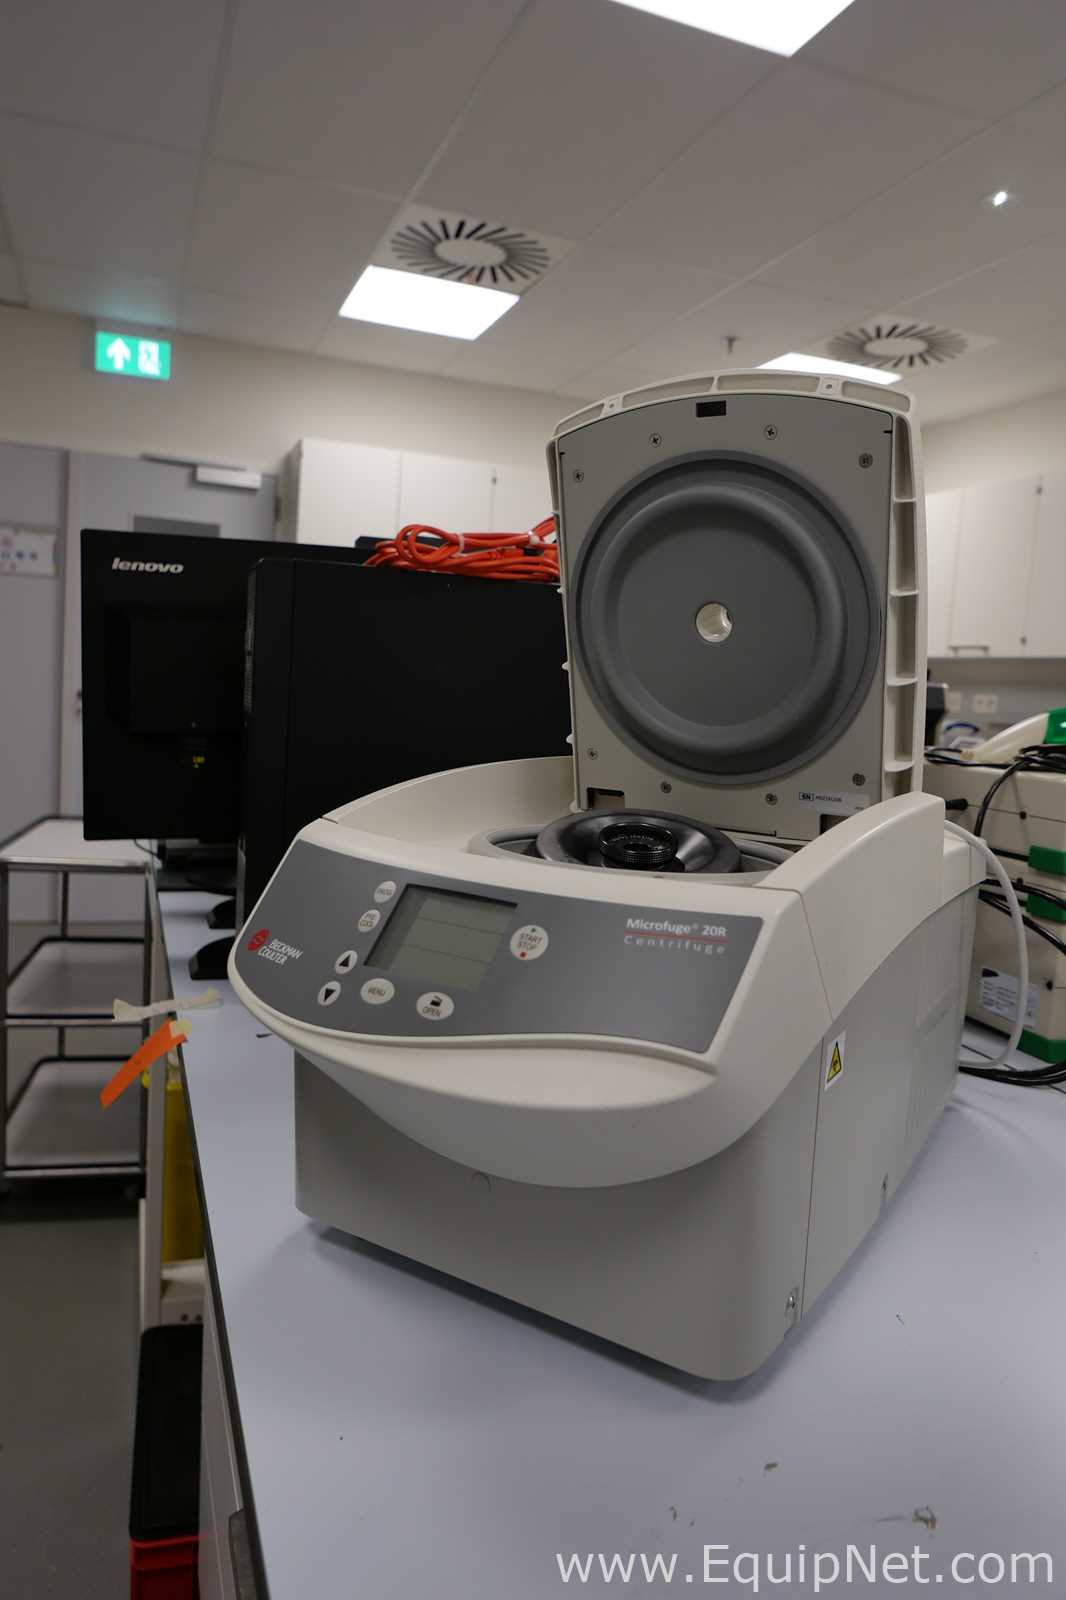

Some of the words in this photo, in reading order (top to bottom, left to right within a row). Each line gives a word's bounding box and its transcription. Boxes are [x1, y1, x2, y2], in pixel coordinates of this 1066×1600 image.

[112, 557, 184, 574] lenovo
[519, 932, 544, 944] START
[702, 925, 727, 937] 20R
[268, 938, 304, 959] BECKMAN
[623, 935, 726, 955] Centrifuge
[258, 945, 288, 965] COULTER
[422, 1006, 442, 1017] OPEN
